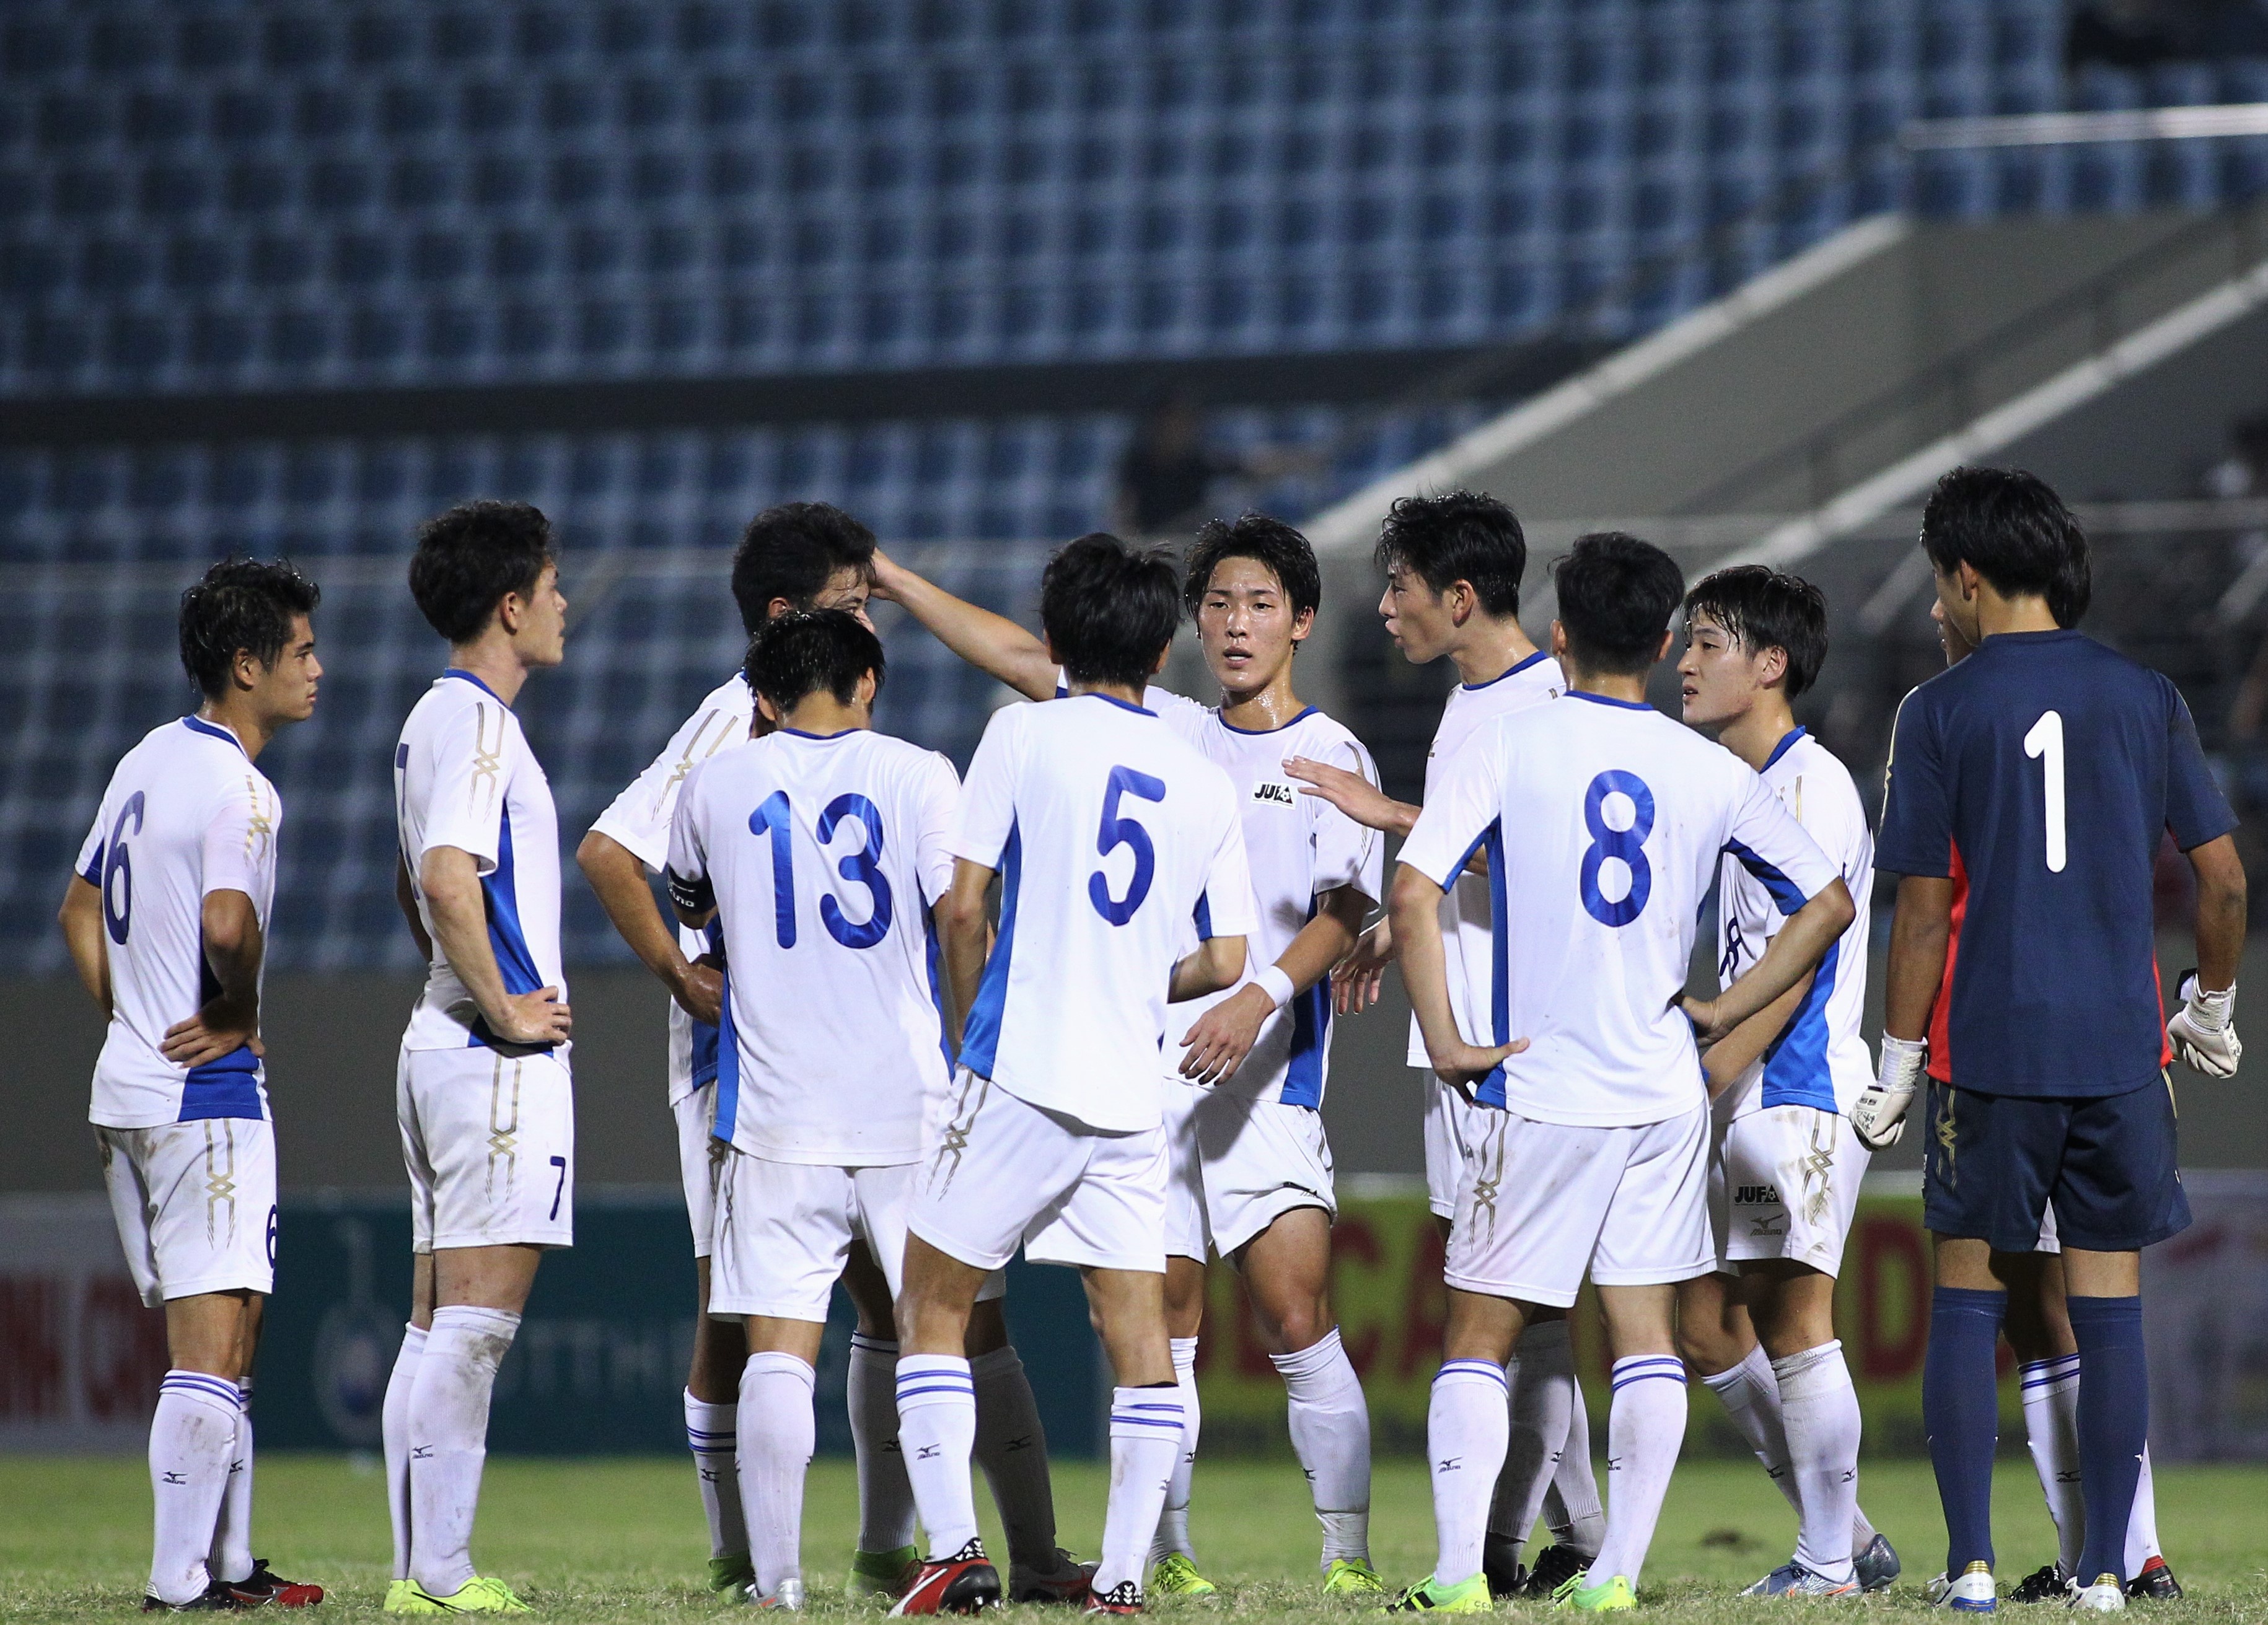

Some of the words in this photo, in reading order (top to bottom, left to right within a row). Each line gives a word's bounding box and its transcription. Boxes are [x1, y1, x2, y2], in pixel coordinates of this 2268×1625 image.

[102, 790, 145, 945] 6
[749, 790, 892, 949] 13
[1088, 764, 1166, 927] 5
[1580, 769, 1655, 927] 8
[2023, 709, 2067, 874] 1
[550, 1155, 565, 1220] 7
[1734, 1184, 1780, 1203] JUFA
